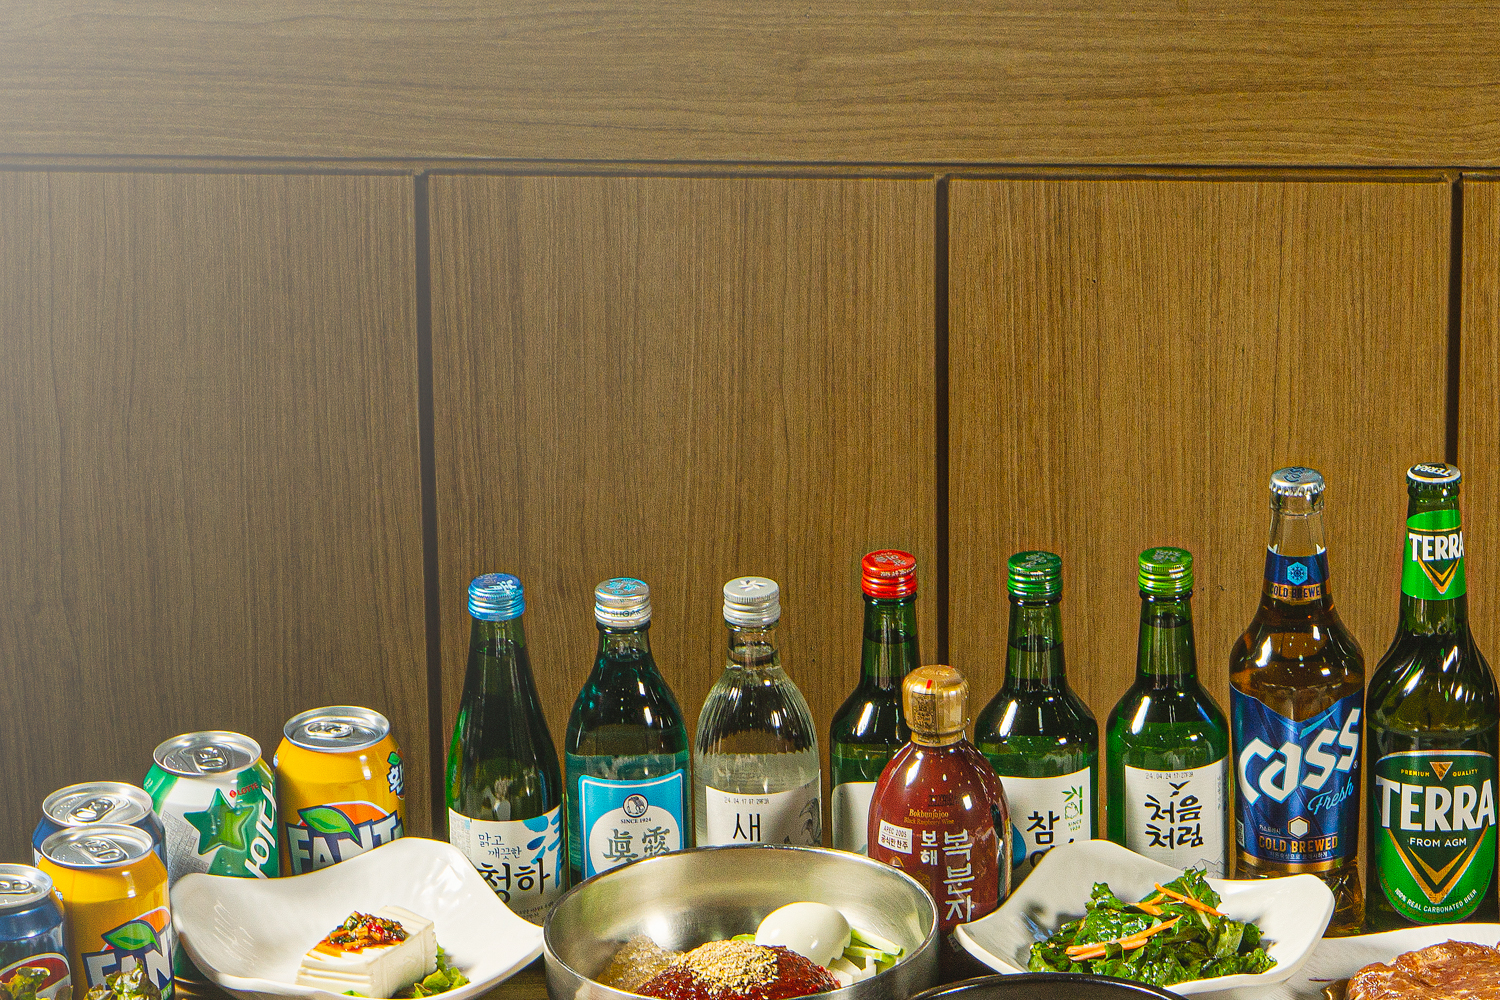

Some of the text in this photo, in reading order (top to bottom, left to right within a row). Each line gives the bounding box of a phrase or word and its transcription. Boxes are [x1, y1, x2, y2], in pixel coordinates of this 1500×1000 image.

[1408, 531, 1465, 561] TERRA
[1400, 768, 1478, 777] PREMIUM QUALITY
[237, 782, 259, 796] LOTTE
[1307, 776, 1354, 815] Fresh
[1375, 774, 1496, 832] TERRA
[1144, 794, 1203, 824] 처음
[478, 832, 505, 847] 맑고
[733, 813, 761, 842] 새
[1026, 811, 1060, 845] 참
[1144, 823, 1204, 849] 처럼
[286, 814, 404, 874] FANT
[488, 846, 522, 860] 깨끗한
[921, 830, 938, 866] 보해
[1259, 835, 1338, 853] COLD BREWED
[1409, 837, 1467, 848] FROM AGM
[476, 858, 551, 904] 청하
[941, 828, 975, 922] 복분자
[1406, 898, 1422, 911] REAL
[1423, 901, 1464, 914] CARBONATED
[1463, 888, 1479, 904] BEER
